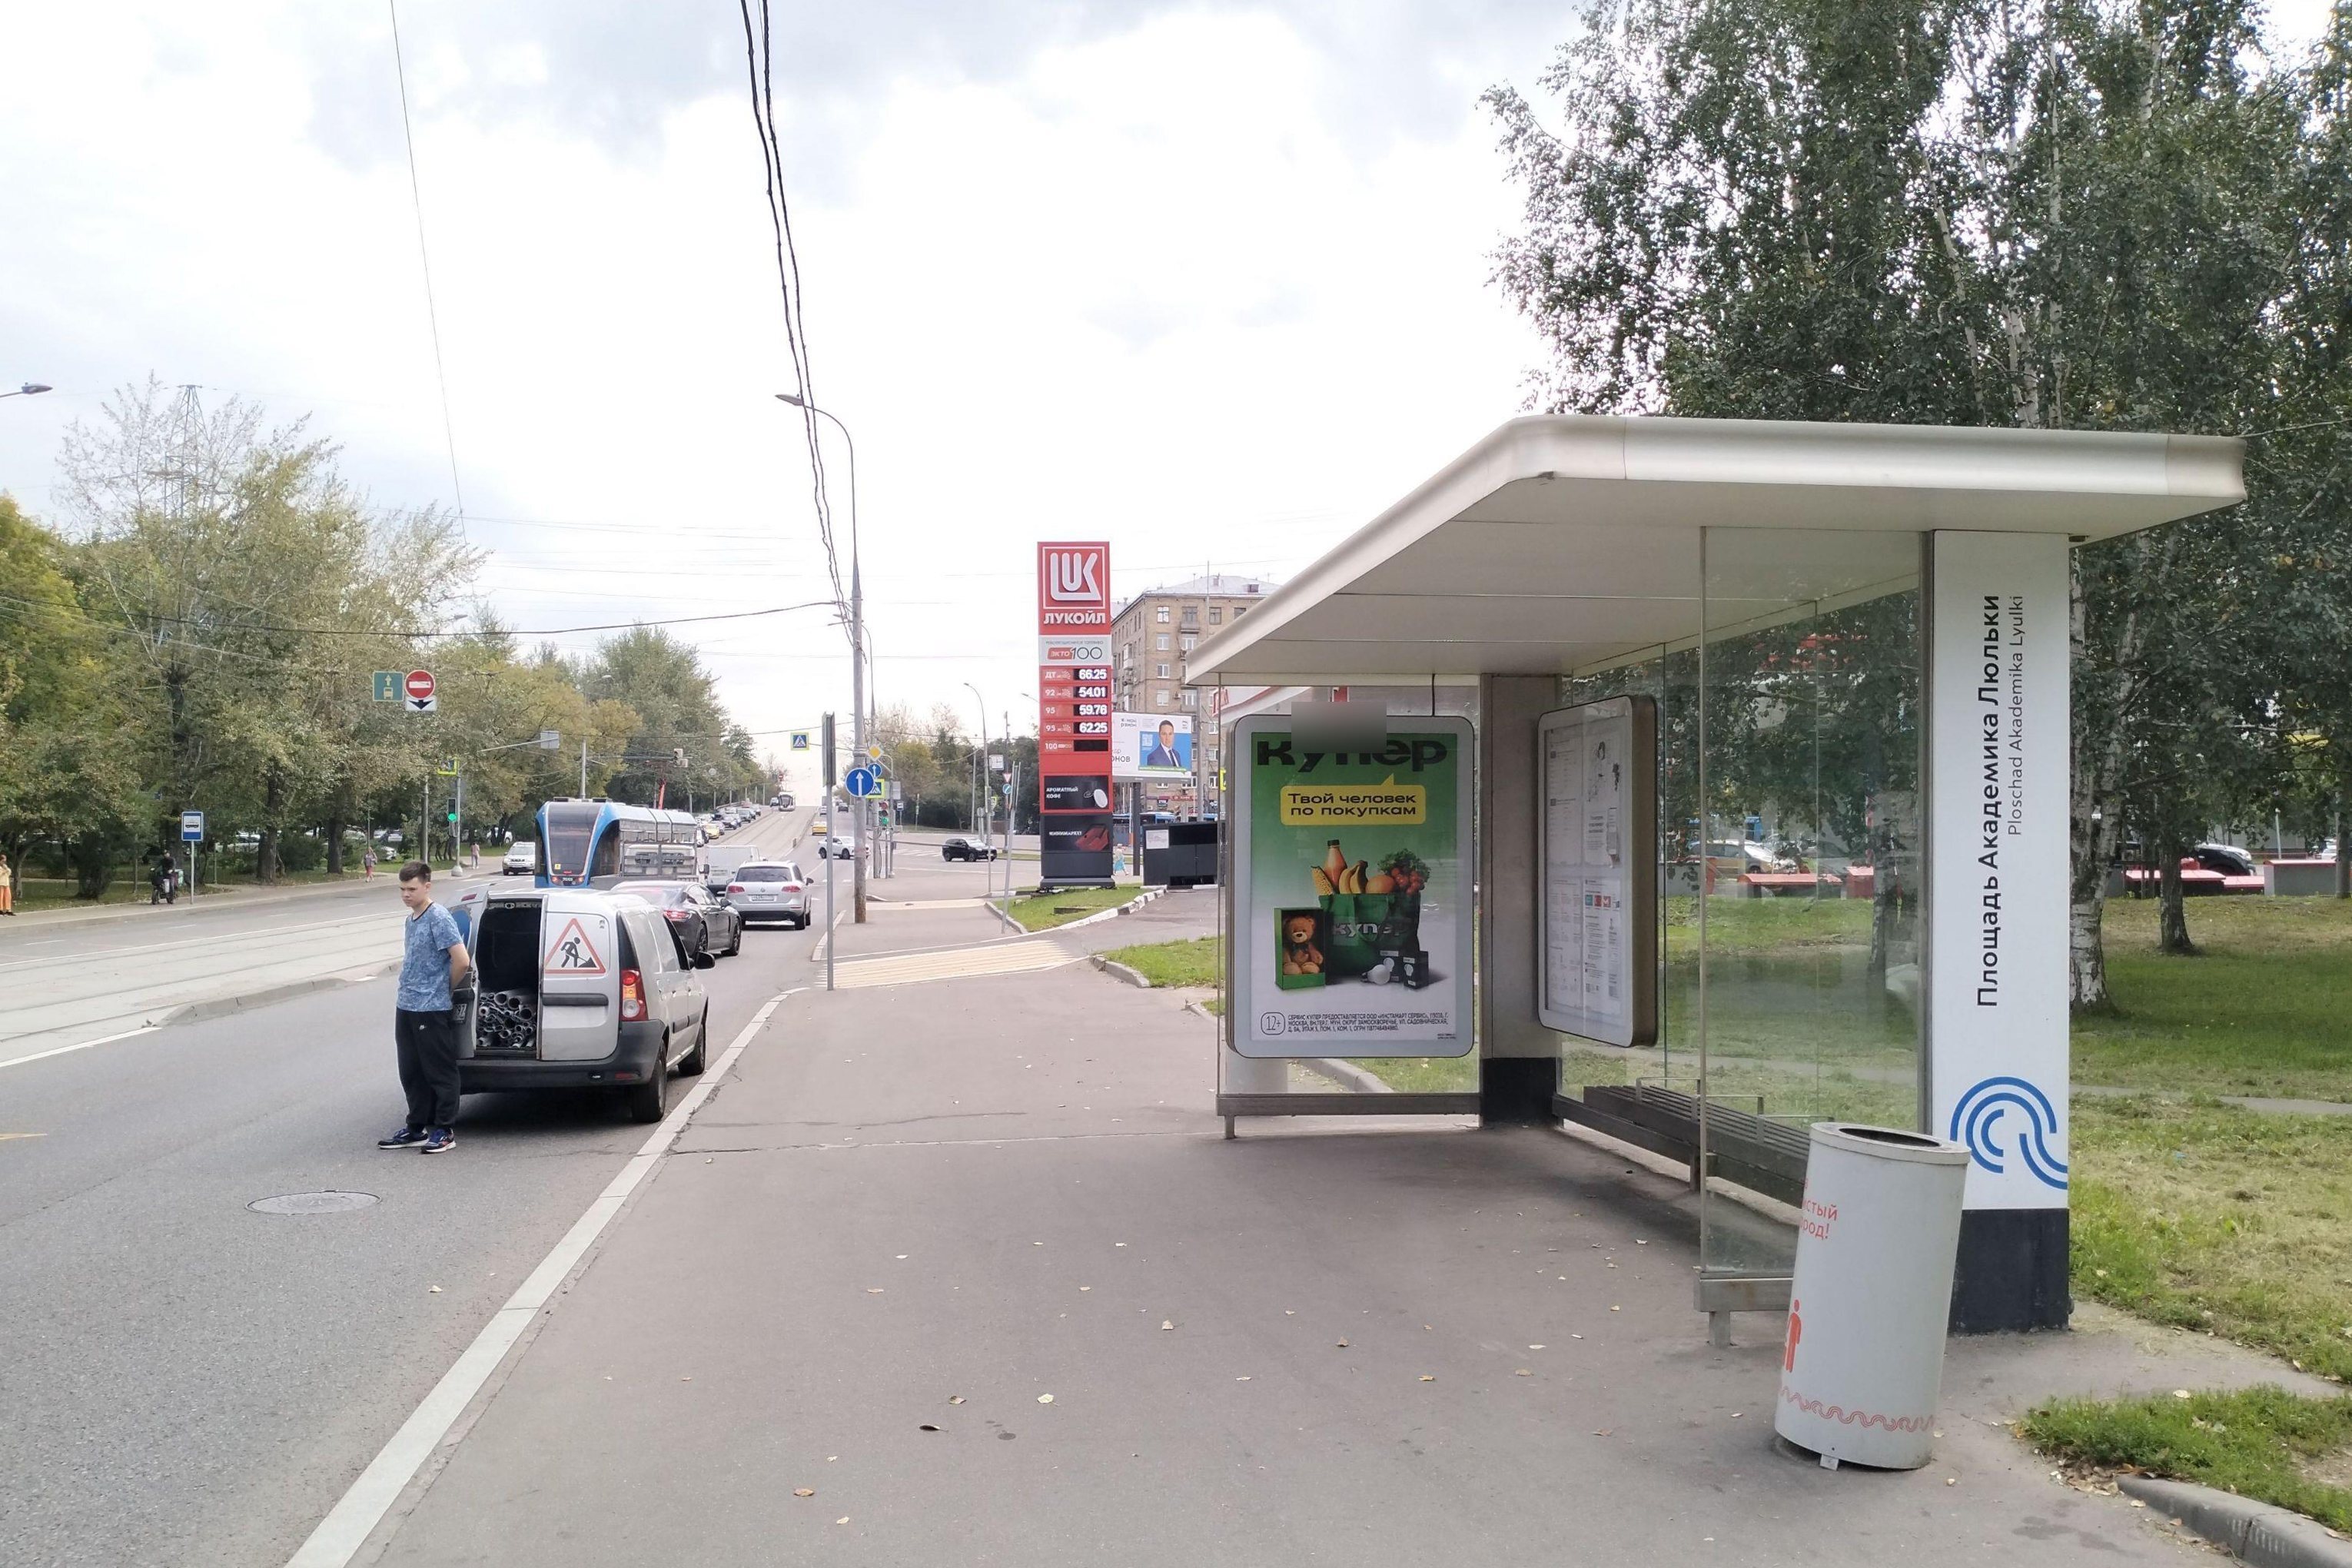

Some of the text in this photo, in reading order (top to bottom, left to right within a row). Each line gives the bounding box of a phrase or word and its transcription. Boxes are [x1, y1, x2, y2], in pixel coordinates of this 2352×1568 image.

[1043, 611, 1106, 625] ЛУКОЙЛ
[1071, 646, 1103, 660] 100
[1045, 671, 1057, 679] ДТ
[1078, 669, 1108, 680] 66.25
[1078, 686, 1107, 698] 54.01
[2007, 596, 2025, 835] Ploschad Akademika Lyulki
[1078, 722, 1108, 733] 62.25
[1287, 792, 1417, 804] Твой человек
[1976, 596, 2002, 1007] Площадь Академика Люльки
[1291, 807, 1417, 818] по покупкам
[1266, 1015, 1281, 1031] 12+
